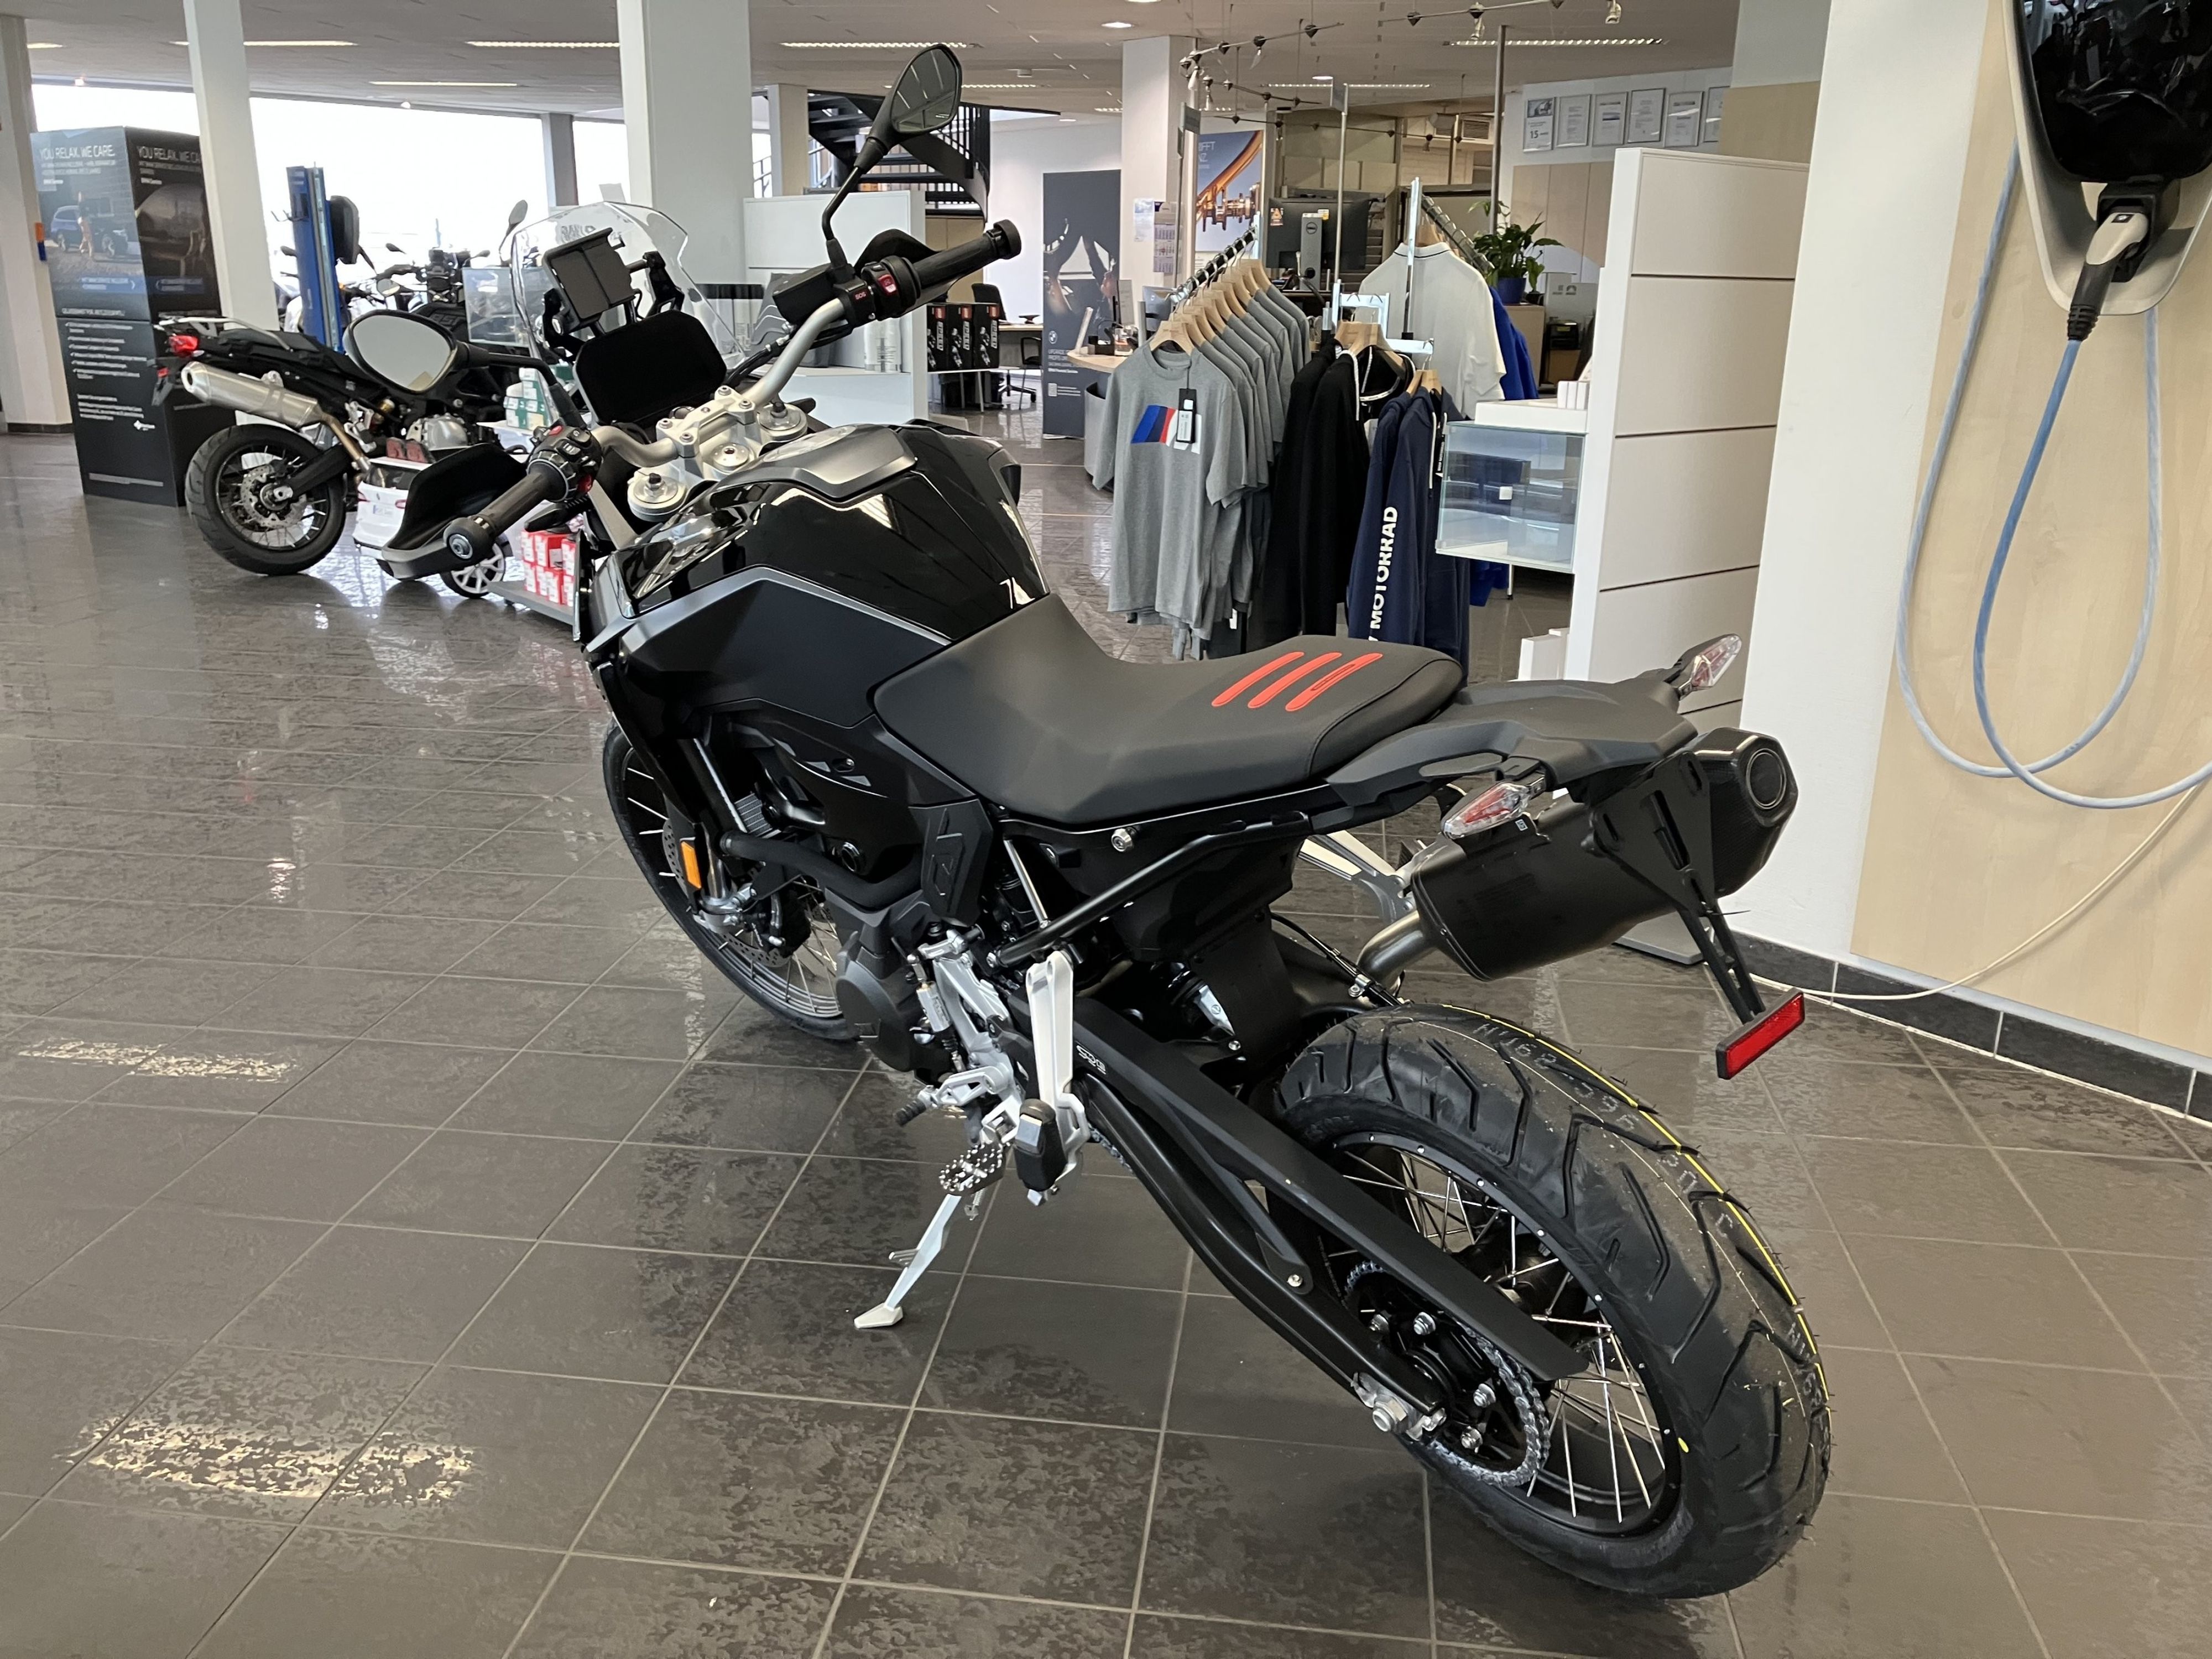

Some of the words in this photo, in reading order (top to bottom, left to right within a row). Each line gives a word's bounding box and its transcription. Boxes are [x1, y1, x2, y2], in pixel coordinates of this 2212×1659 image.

[40, 148, 54, 160] YOU
[81, 145, 93, 158] WE
[1370, 506, 1398, 629] MOTORRAD
